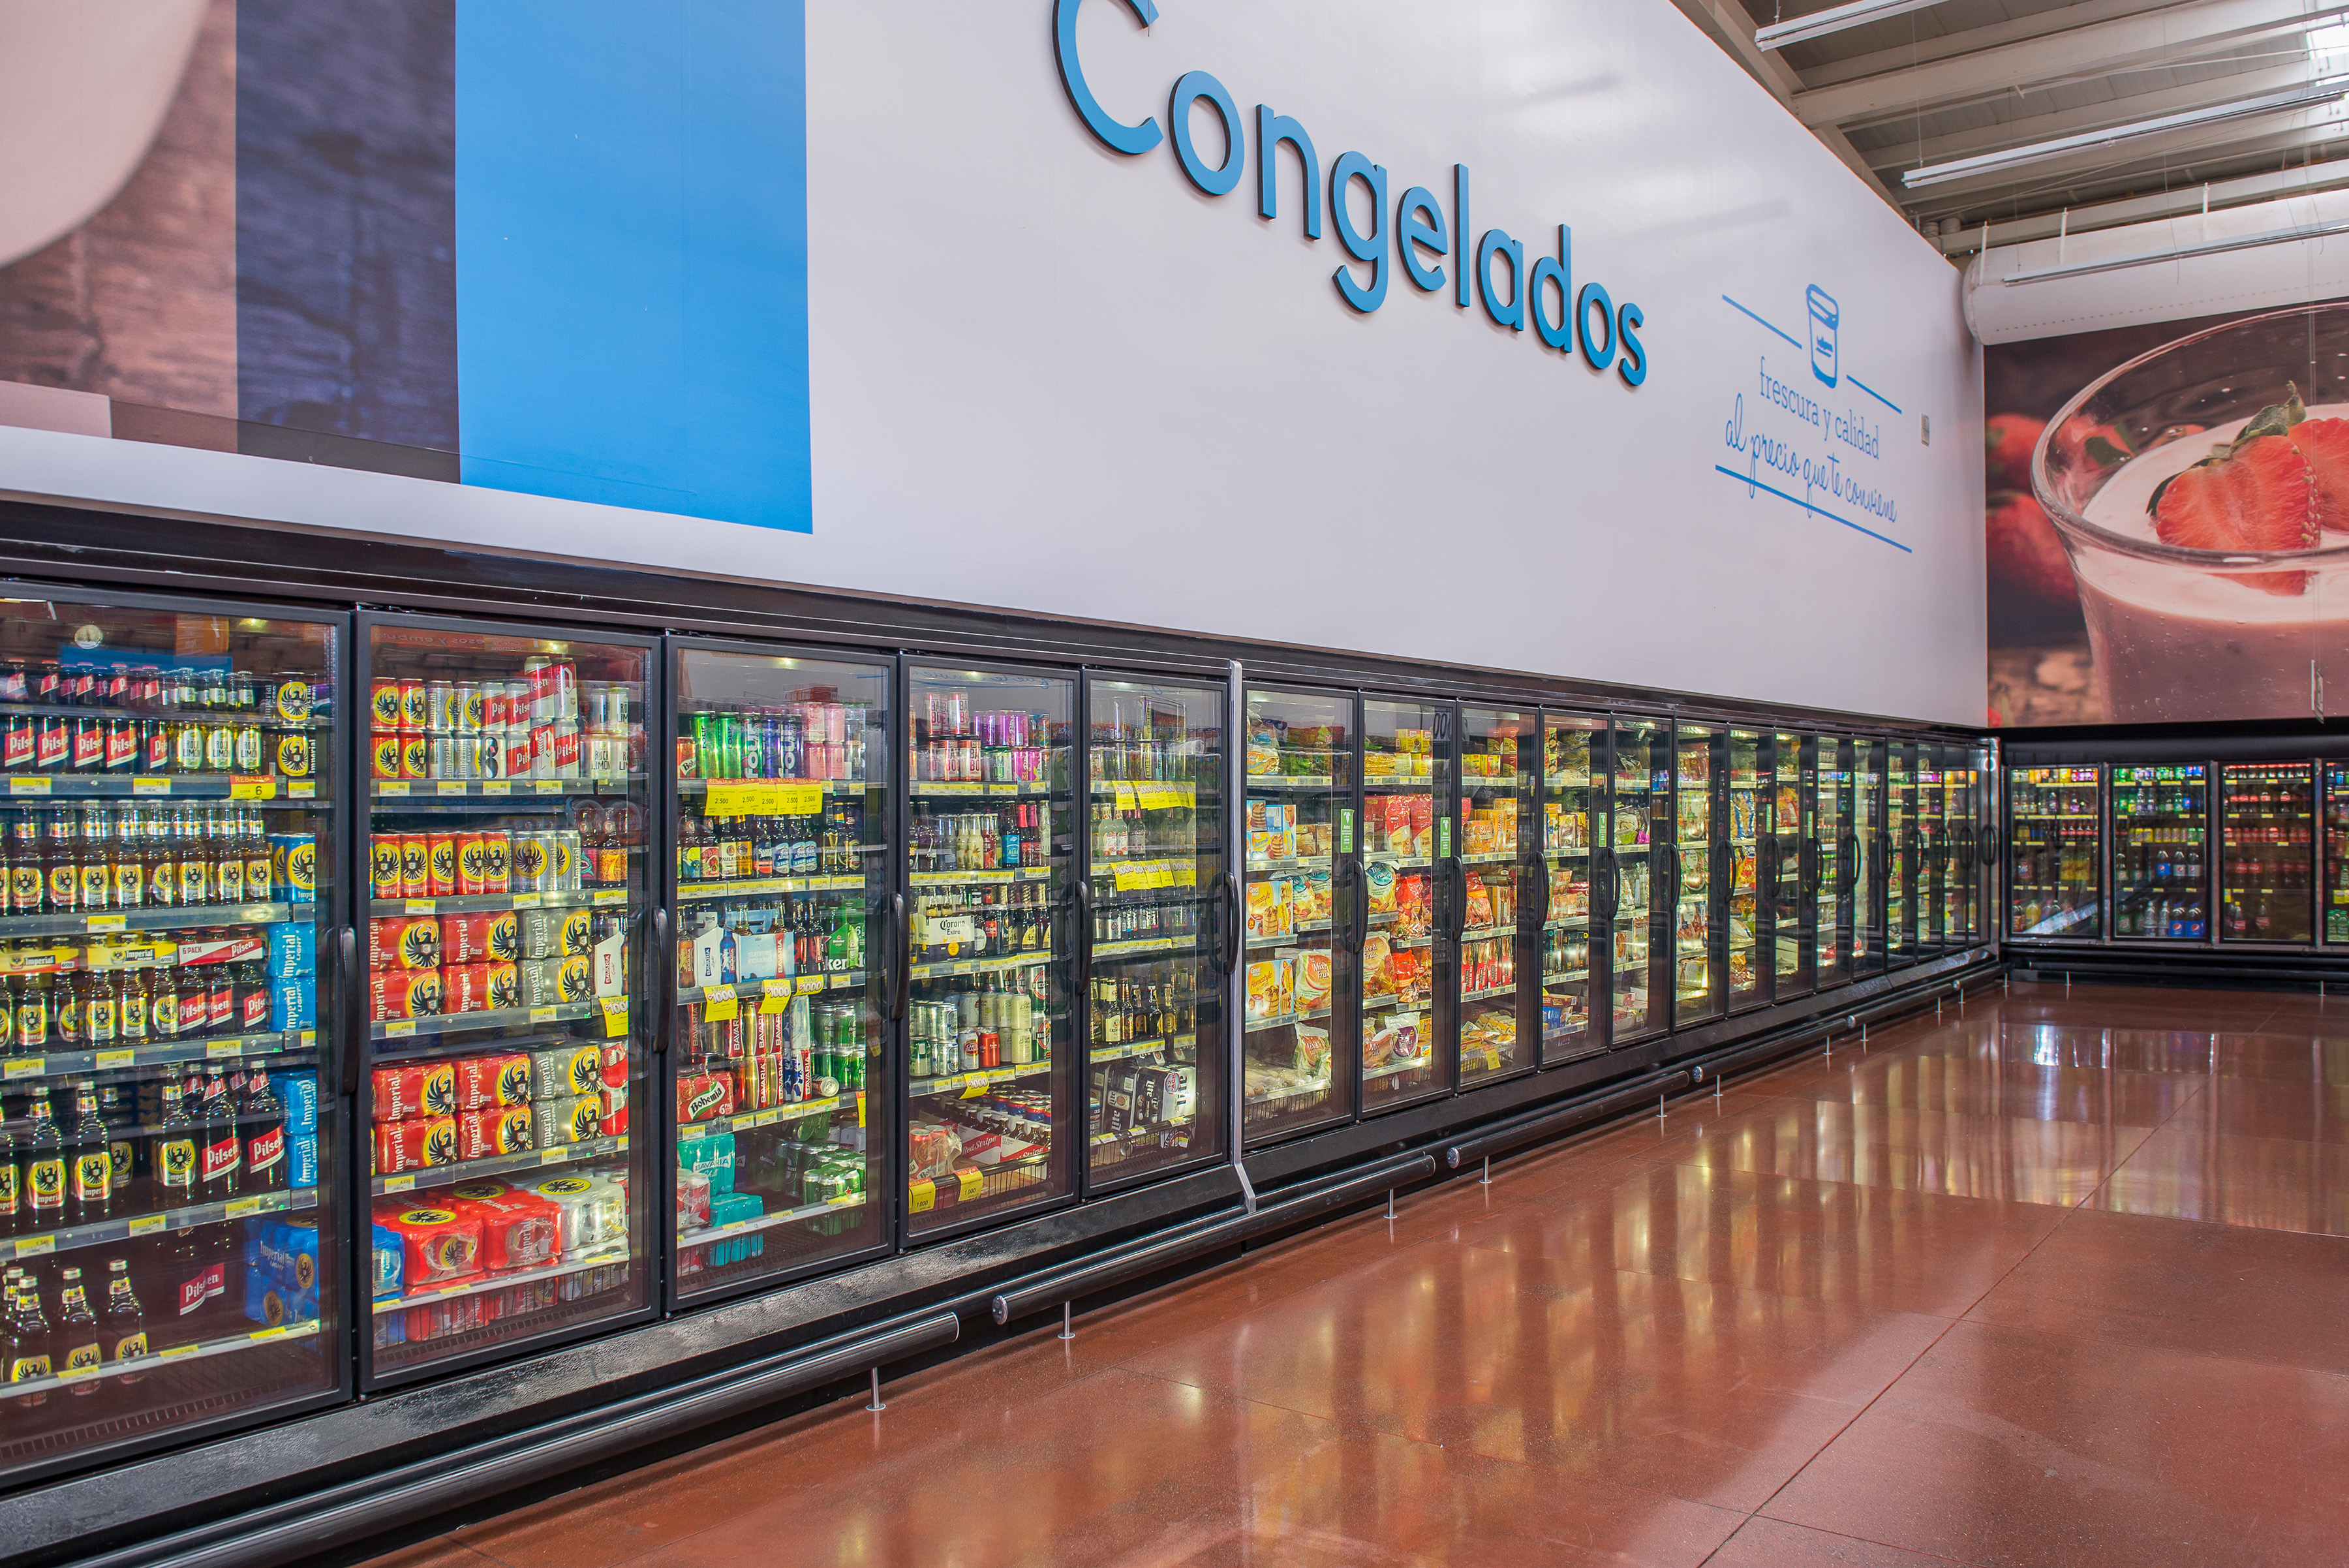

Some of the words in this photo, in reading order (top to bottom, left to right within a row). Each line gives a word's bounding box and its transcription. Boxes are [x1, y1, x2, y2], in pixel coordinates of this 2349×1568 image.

[1052, 0, 1647, 386] Congelados
[1760, 356, 1819, 426] frescura
[1823, 408, 1831, 441] y
[1835, 409, 1879, 459] calidad
[1725, 393, 1747, 452] al
[1749, 433, 1800, 499] precio
[1804, 458, 1829, 518] que
[1827, 452, 1843, 497] te
[1845, 478, 1897, 523] conviene
[255, 786, 262, 795] 6
[604, 853, 619, 881] 7
[455, 919, 470, 962] Imperial
[531, 917, 545, 959] Imperial
[940, 919, 966, 930] Corona
[25, 956, 54, 966] Imperial
[126, 949, 154, 959] Imperial
[231, 940, 254, 957] Pilsen
[279, 934, 297, 979] Imperial
[371, 980, 388, 1021] mperial
[459, 972, 471, 1012] mperial
[527, 965, 542, 1006] Imperial
[179, 1002, 206, 1021] Pilsen
[282, 986, 299, 1029] mperial
[465, 1065, 481, 1109] Imperial
[537, 1056, 553, 1098] Imperial
[1176, 1075, 1188, 1106] Lite
[298, 1079, 313, 1126] Imperial
[387, 1076, 405, 1121] Imperial
[690, 1087, 723, 1114] Bohemia
[719, 1103, 726, 1115] 6
[465, 1115, 482, 1158] Imperial
[540, 1109, 555, 1148] mperial
[962, 1145, 975, 1155] Red
[975, 1135, 997, 1149] Stripe
[207, 1143, 238, 1169] Pilsen
[297, 1139, 311, 1183] Imperial
[390, 1130, 406, 1173] Imperial
[695, 1158, 729, 1172] BAVARIA
[260, 1240, 285, 1265] Imperial
